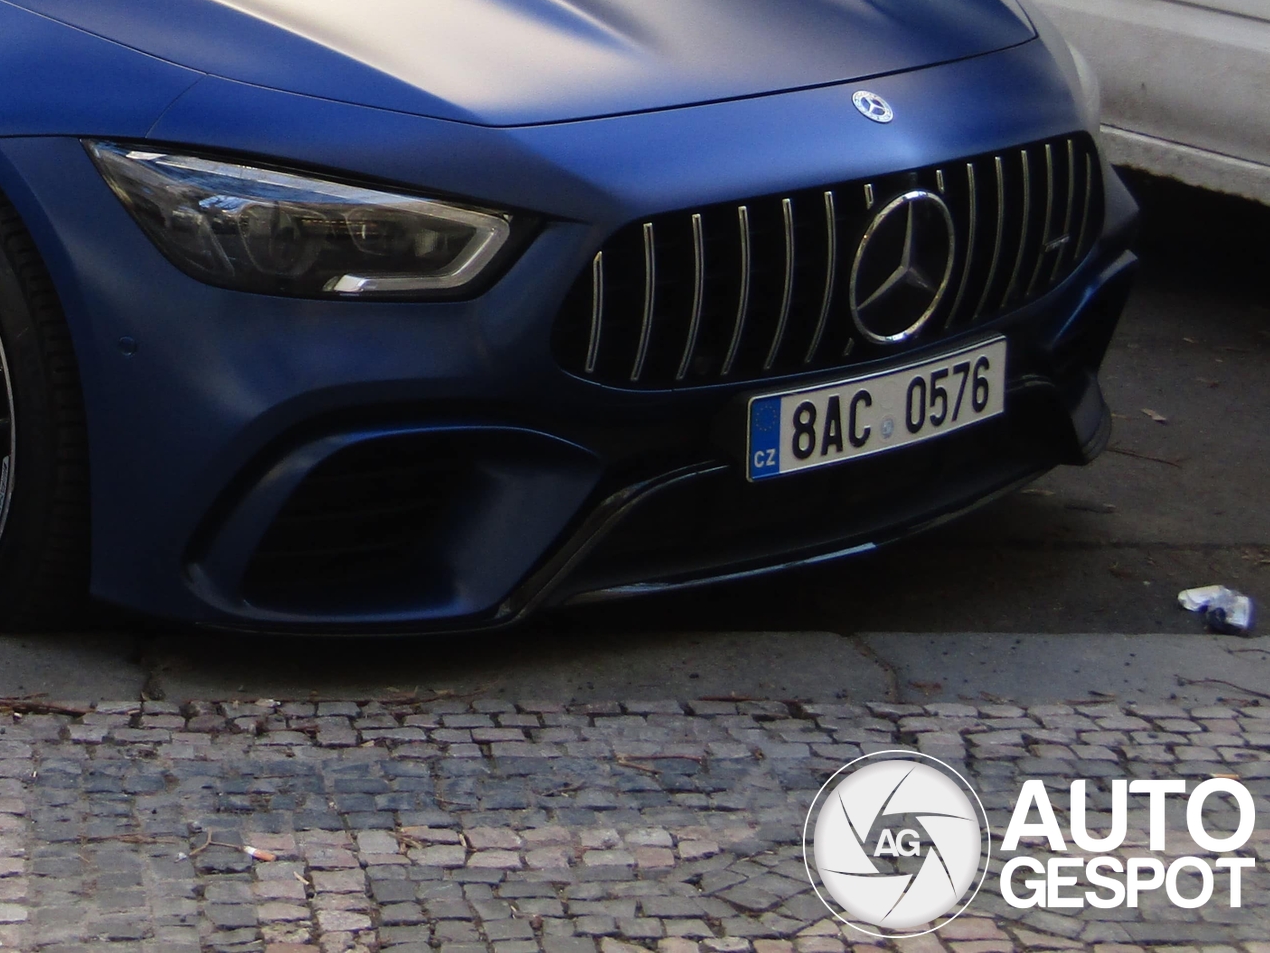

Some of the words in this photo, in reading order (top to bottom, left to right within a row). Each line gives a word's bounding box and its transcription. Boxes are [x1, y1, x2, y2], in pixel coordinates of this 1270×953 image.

[791, 389, 873, 460] 8AC
[905, 355, 990, 435] 0576
[754, 449, 776, 468] CZ
